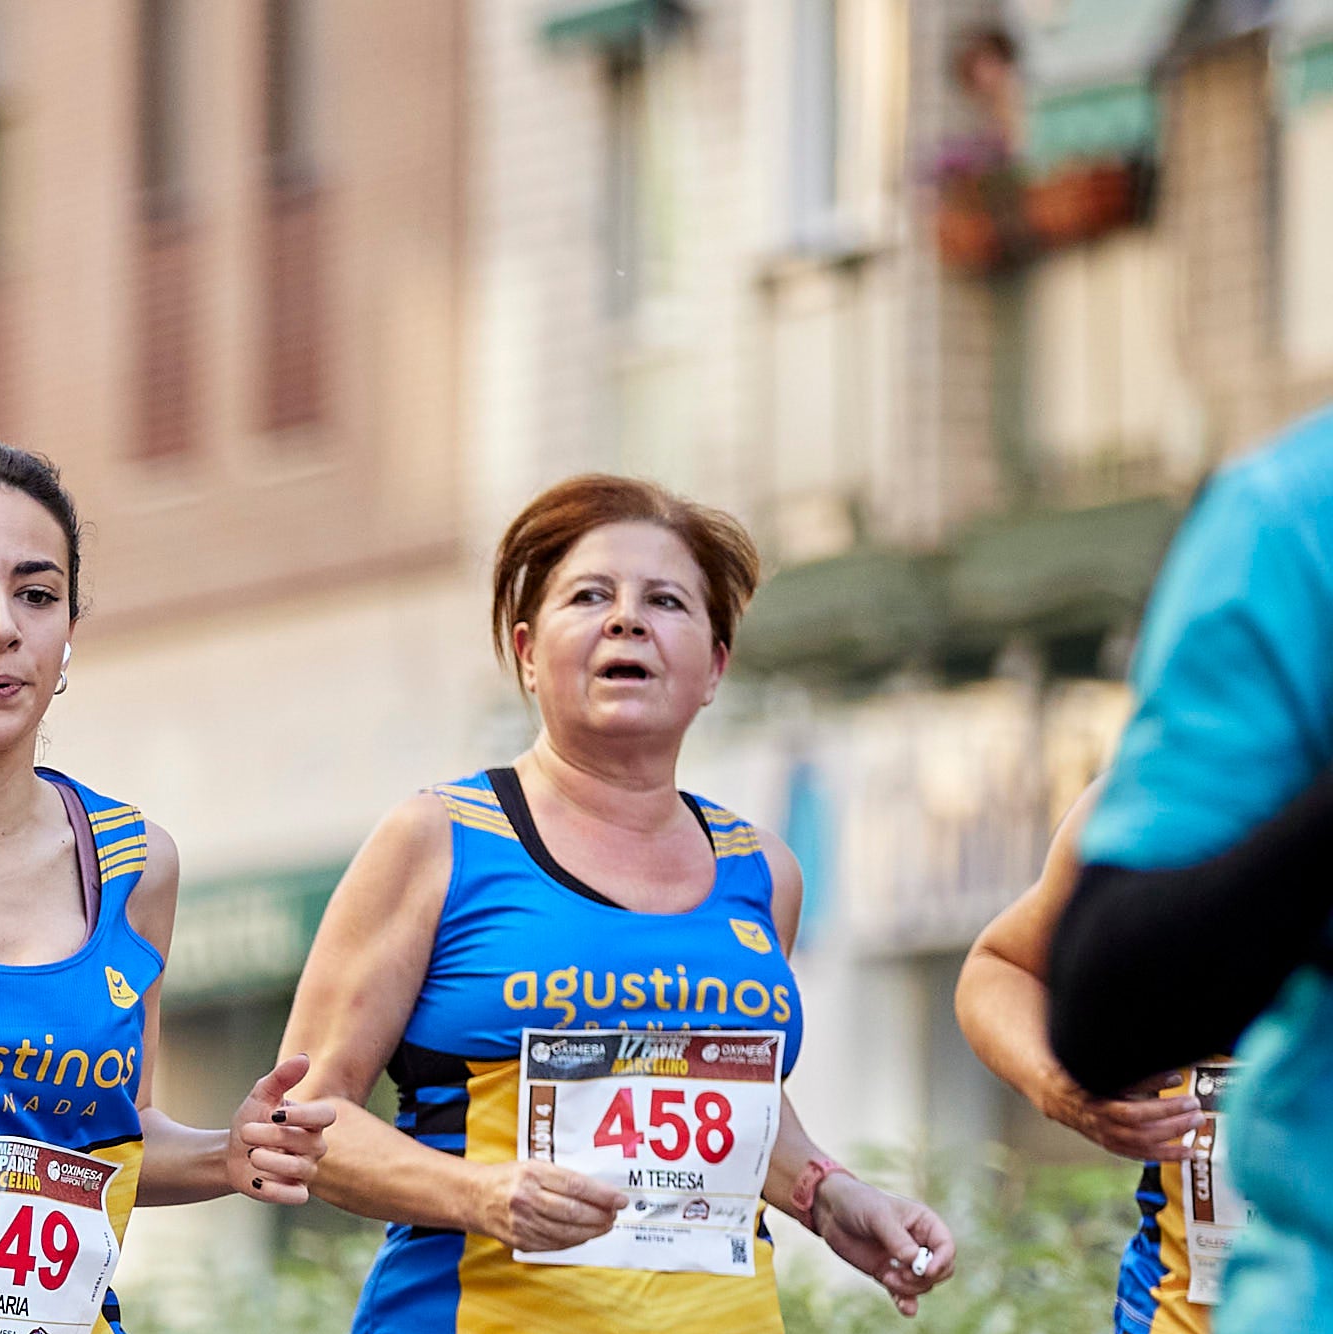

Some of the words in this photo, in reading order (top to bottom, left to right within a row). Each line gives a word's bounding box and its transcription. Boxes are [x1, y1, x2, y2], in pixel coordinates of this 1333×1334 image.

[503, 964, 792, 1025] agustinos
[618, 1036, 644, 1060] 17
[721, 1043, 772, 1057] OXIMESA
[611, 1058, 690, 1077] MARCELINO
[593, 1087, 735, 1164] 458
[61, 1163, 104, 1182] OXIMESA
[629, 1169, 643, 1187] M
[645, 1169, 705, 1190] TERESA
